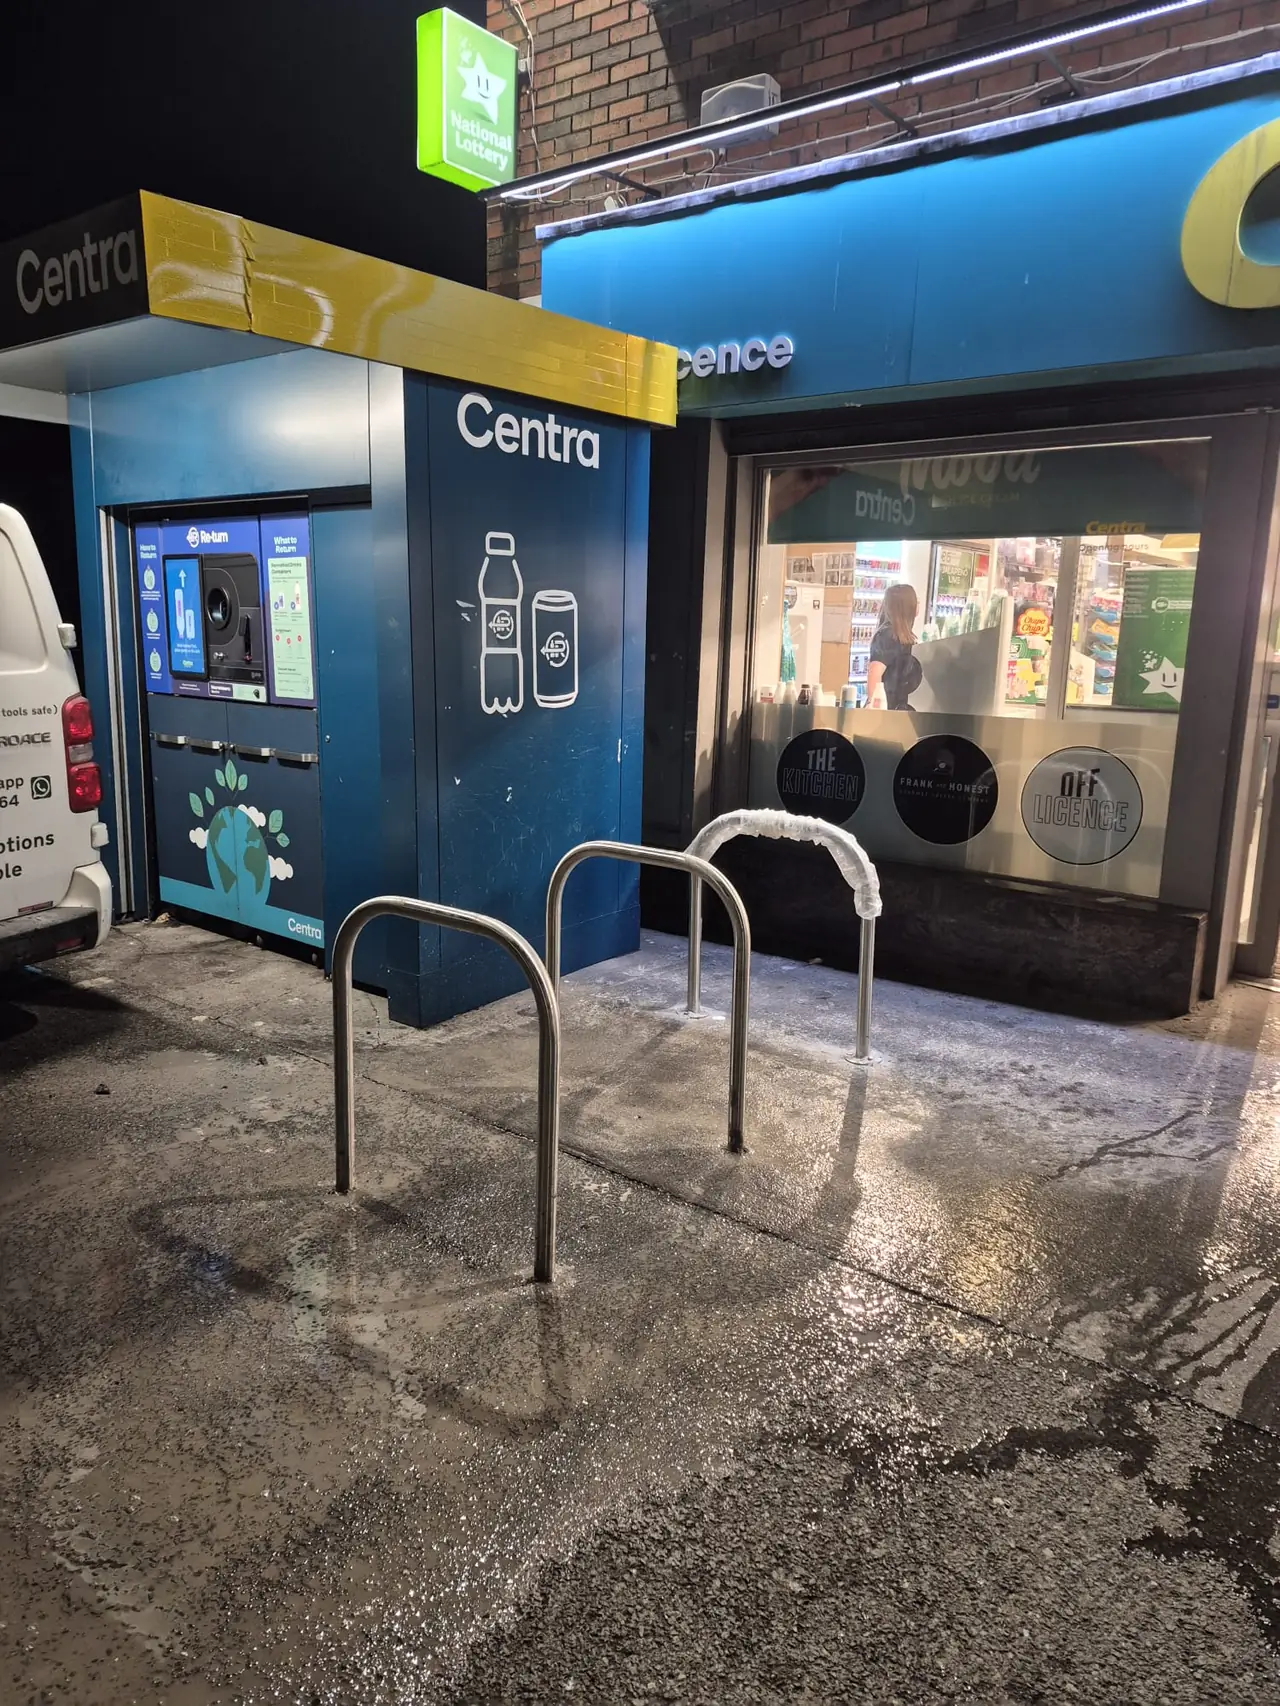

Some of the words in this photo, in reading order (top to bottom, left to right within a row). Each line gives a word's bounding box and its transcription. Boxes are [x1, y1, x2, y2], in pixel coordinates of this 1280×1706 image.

[451, 109, 512, 152] National
[455, 131, 508, 171] Lottery
[16, 229, 138, 314] Centra
[457, 392, 602, 470] Centra
[1086, 521, 1146, 534] Centra
[1021, 623, 1044, 632] Chups
[1024, 616, 1046, 625] Chupa
[2, 707, 28, 717] tools
[807, 747, 837, 771] THE
[0, 777, 24, 791] app
[782, 767, 859, 801] KITCHEN
[900, 777, 933, 789] FRANK
[948, 781, 990, 795] HONEST
[1060, 768, 1101, 797] OFF
[0, 795, 20, 808] 64
[1033, 794, 1129, 833] LICENCE
[288, 917, 322, 940] Centra
